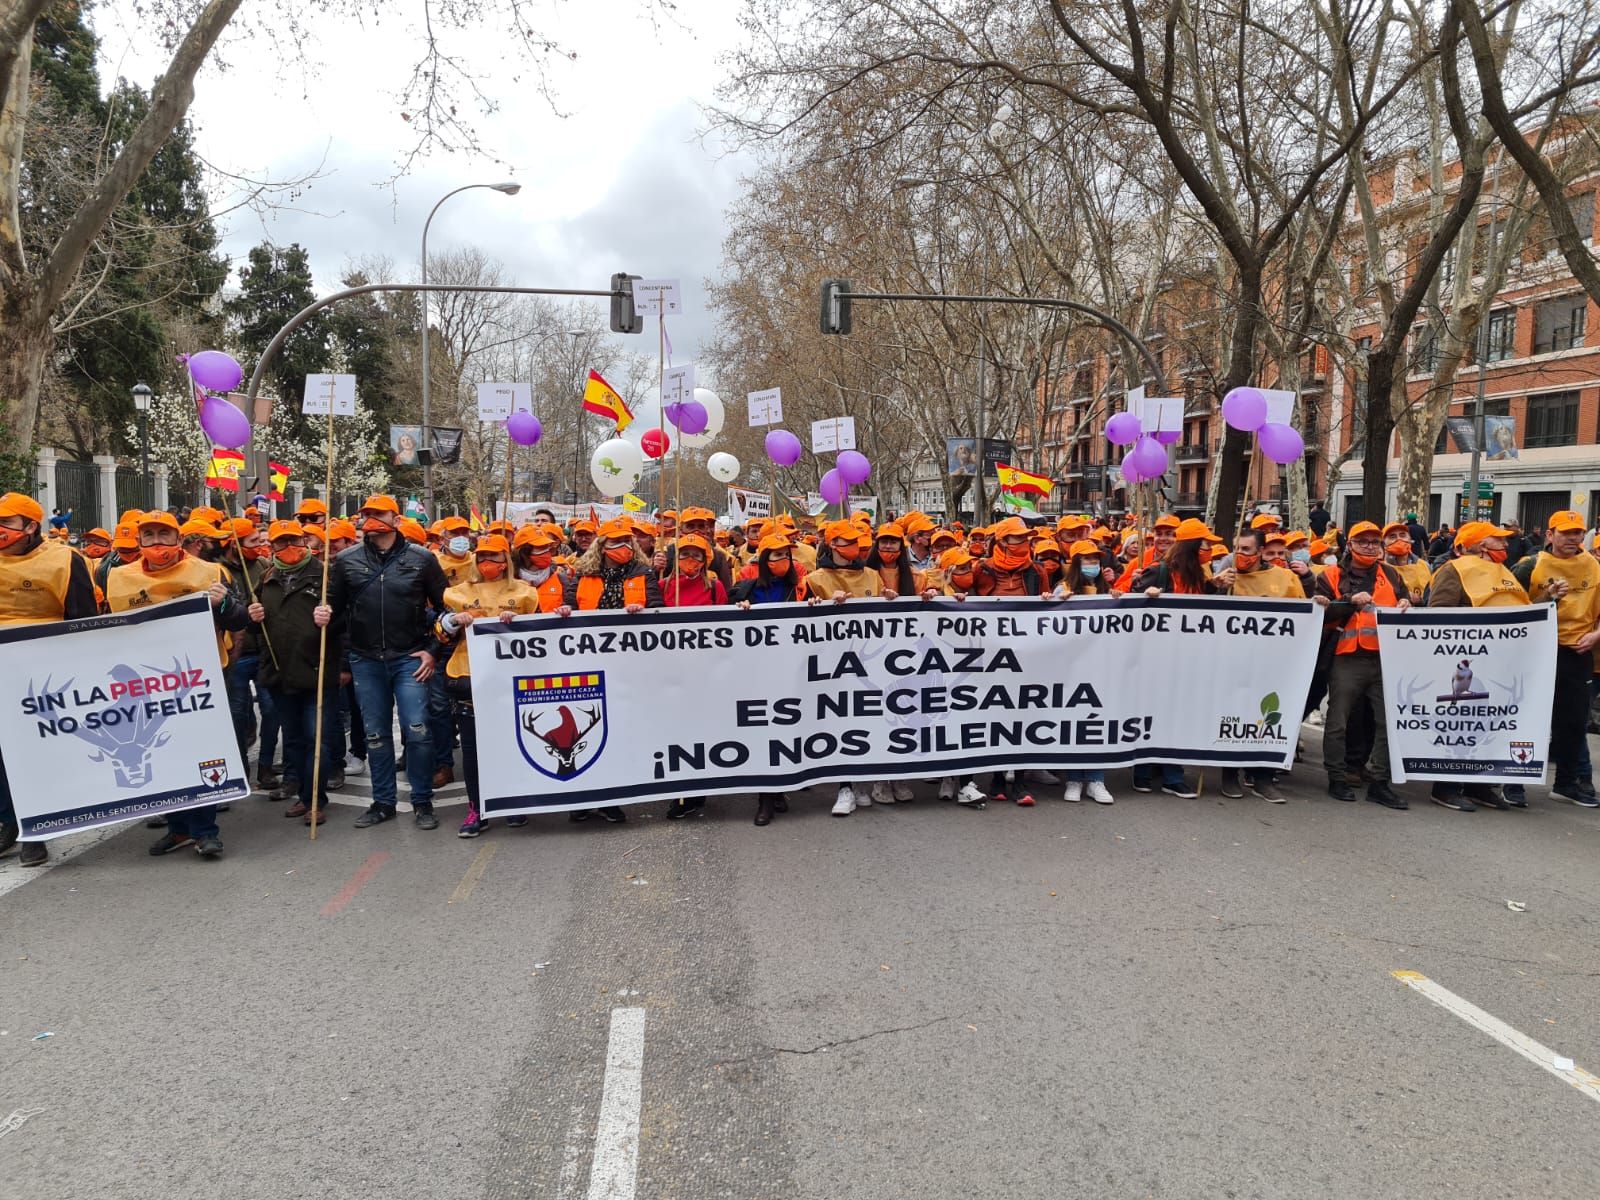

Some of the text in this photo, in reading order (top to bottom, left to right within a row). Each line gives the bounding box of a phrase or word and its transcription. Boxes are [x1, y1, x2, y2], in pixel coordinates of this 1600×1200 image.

[89, 619, 100, 627] LA
[494, 613, 1295, 661] LOS CAZADORES DE ALICANTE, POR EL FUTURO DE LA CAZA
[1396, 626, 1528, 640] LA JUSTICIA NOS
[1433, 644, 1489, 656] AVALA
[807, 647, 1024, 682] LA CAZA
[20, 668, 211, 715] SIN LA PERDIZ,
[517, 692, 604, 703] COMUNIDAD VALENCIANA
[736, 682, 1104, 728] ES NECESARIA
[1396, 704, 1519, 717] Y EL GOBIERNO
[37, 692, 214, 738] NO SOY FELIZ
[1219, 723, 1287, 739] RURAL
[1396, 719, 1518, 733] NOS QUITA LAS
[653, 712, 1154, 780] ¡NO NOS SILENCIÉIS!
[1433, 735, 1477, 747] ALAS
[1419, 761, 1430, 769] AL
[1431, 762, 1495, 771] SILVESTRISMO
[32, 795, 189, 832] ¿DÓNDE ESTÁ EL SENTIDO COMÚN?
